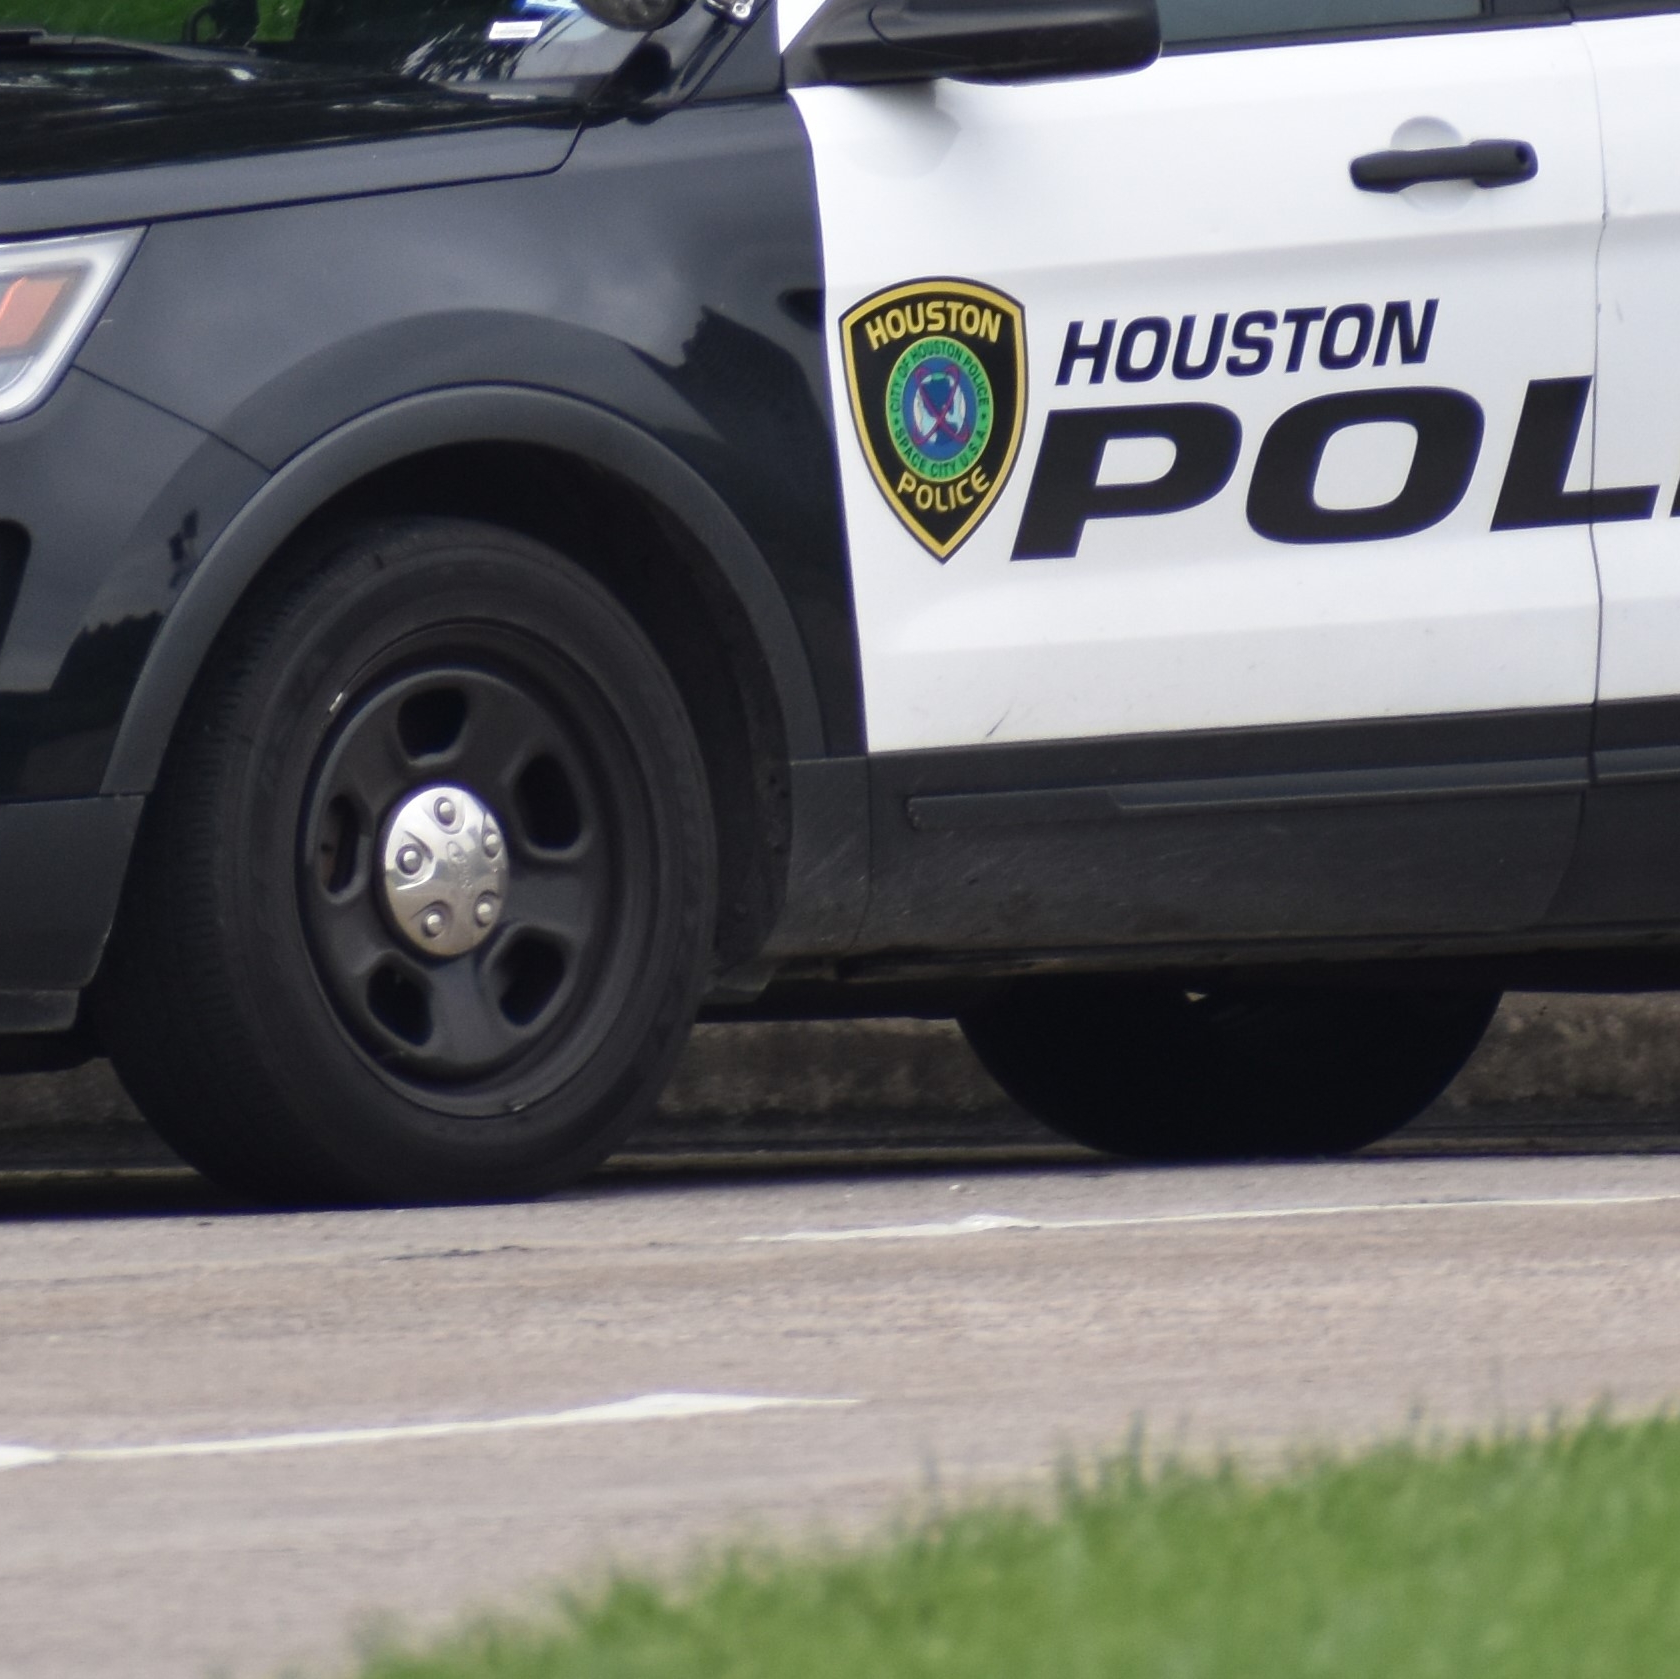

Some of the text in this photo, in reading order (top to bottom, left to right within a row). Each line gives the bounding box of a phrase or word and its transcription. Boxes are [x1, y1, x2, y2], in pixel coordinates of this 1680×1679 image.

[864, 300, 1003, 351] HOUSTON
[1055, 297, 1439, 386] HOUSTON
[911, 341, 962, 363] HOUSTON
[962, 354, 989, 407] POLICE
[895, 427, 927, 470] SPACE
[930, 462, 957, 478] CITY
[896, 465, 991, 513] POLICE
